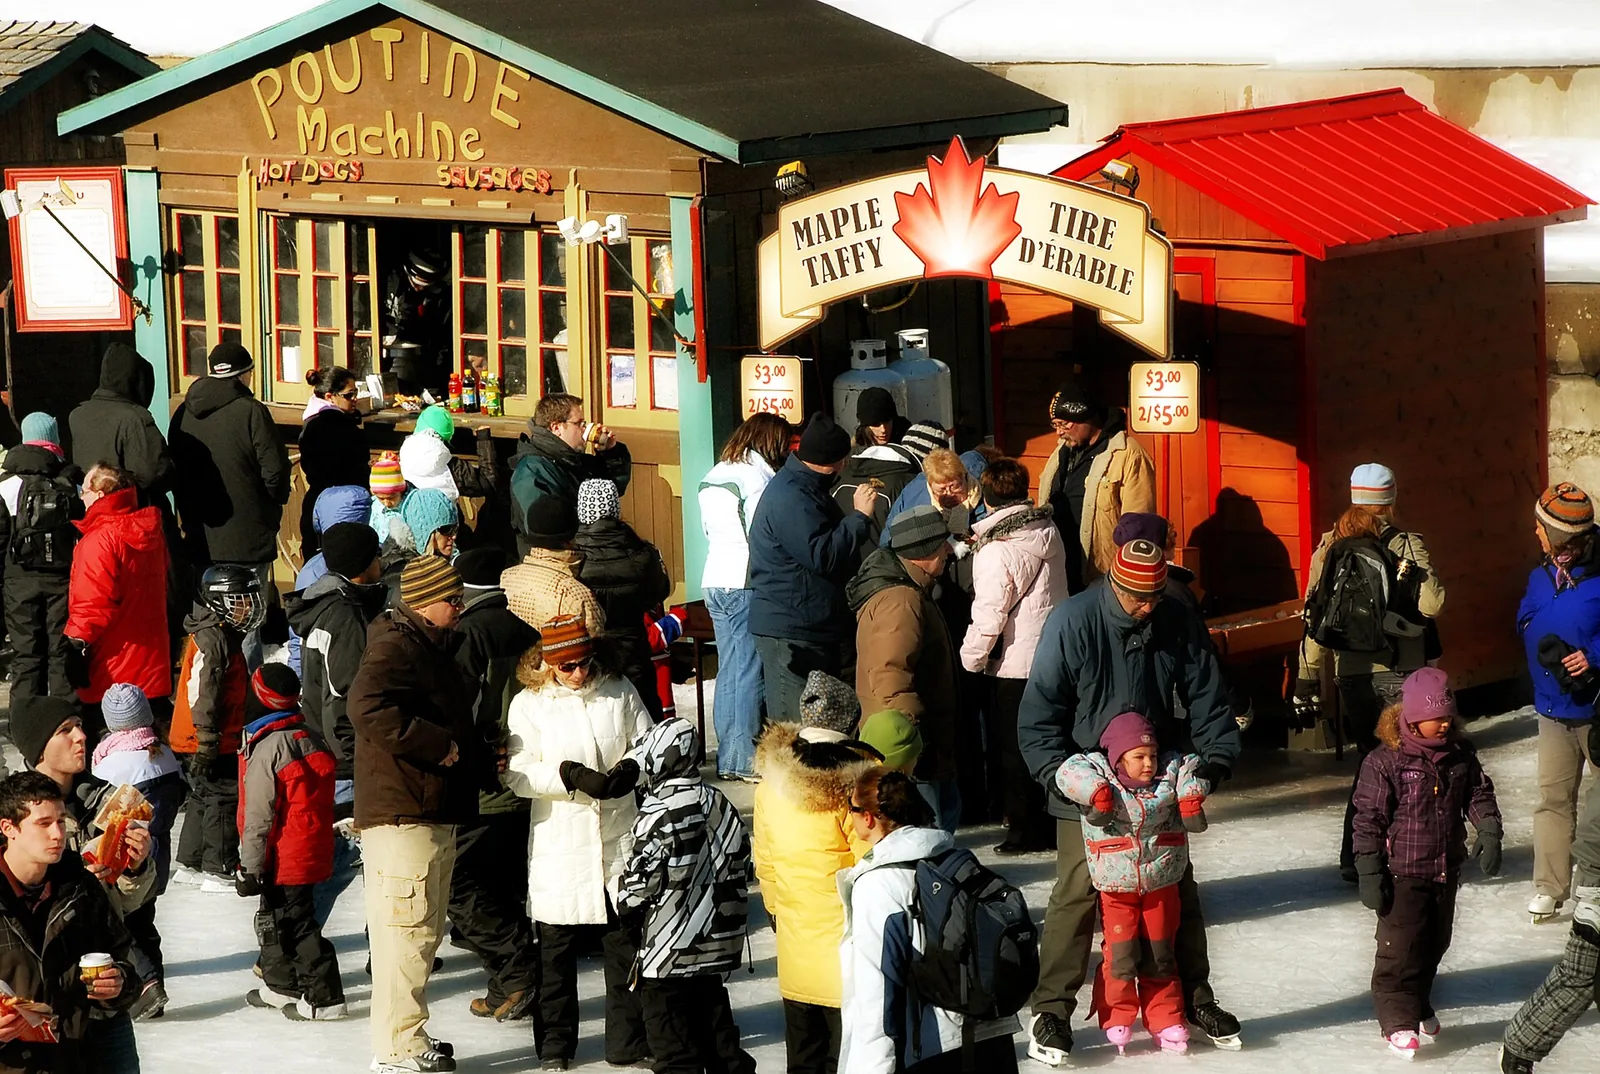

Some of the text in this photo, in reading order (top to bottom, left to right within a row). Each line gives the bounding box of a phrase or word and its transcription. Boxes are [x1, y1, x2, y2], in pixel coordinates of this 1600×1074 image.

[251, 27, 531, 140] POUTINE
[302, 157, 362, 183] DOGS
[792, 197, 883, 251] MAPLE
[1049, 201, 1117, 251] TIRE
[802, 236, 883, 288] TAFFY
[1018, 237, 1135, 296] D'ÉRABLE
[755, 363, 786, 385] $3.00
[1146, 369, 1181, 392] $3.00
[748, 396, 794, 416] 2/$5.00
[1138, 404, 1189, 426] 2/$5.00
